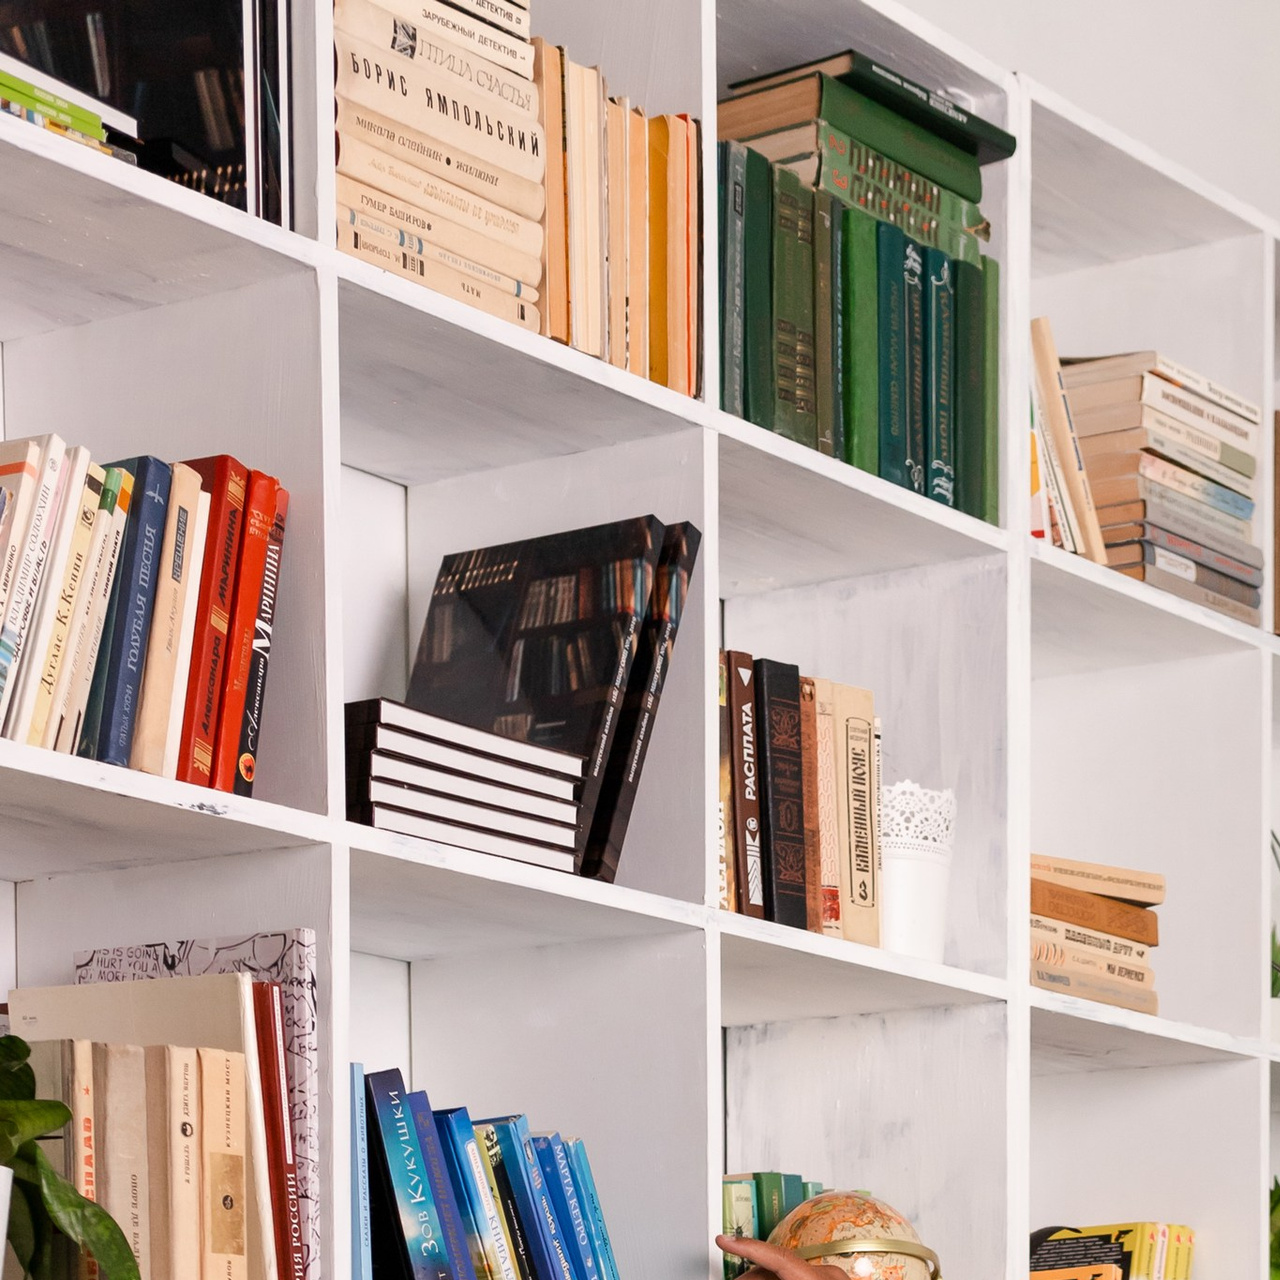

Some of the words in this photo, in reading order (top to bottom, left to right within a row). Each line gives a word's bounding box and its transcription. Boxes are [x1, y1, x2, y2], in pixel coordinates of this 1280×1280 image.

[422, 8, 476, 40] ЗАРУБЕЖНЫЙ
[478, 34, 518, 60] ДЕТЕКТИВ
[350, 52, 408, 97] БОРИС
[425, 87, 540, 158] ЯМПОЛЬСКИЙ
[419, 39, 474, 82] ПТИЦА
[476, 70, 531, 111] СЧАСТЬЯ
[360, 194, 388, 213] ГУМЕР
[2, 544, 17, 594] АВЕРЧЕНКО
[9, 553, 34, 626] ВЛАДИМИР
[29, 484, 51, 552] СОЛОУХИН
[103, 562, 114, 599] ЗОЛОТОЙ
[110, 529, 121, 560] ВЫКУП
[127, 592, 147, 673] ГОЛУБАЯ
[140, 526, 157, 590] ПЕСНЯ
[202, 635, 223, 738] Александра
[219, 507, 239, 607] МАРИНИНА
[41, 634, 64, 696] Дуглас
[248, 656, 265, 751] Александра
[593, 734, 608, 777] выпускной
[603, 706, 615, 734] альбом
[628, 740, 643, 783] выпускной
[638, 712, 650, 740] альбом
[741, 702, 757, 800] РАСПЛАТА
[851, 747, 868, 787] ПОЯС
[852, 788, 870, 873] КАМЕННЫЙ
[96, 957, 124, 970] HURT
[359, 1096, 367, 1143] ЖИВОТНЫХ
[286, 1172, 302, 1249] РОССИИ
[541, 1194, 556, 1236] король
[553, 1144, 572, 1196] МАРТА
[568, 1198, 587, 1246] КЕТРО
[488, 1215, 508, 1263] КНИГА
